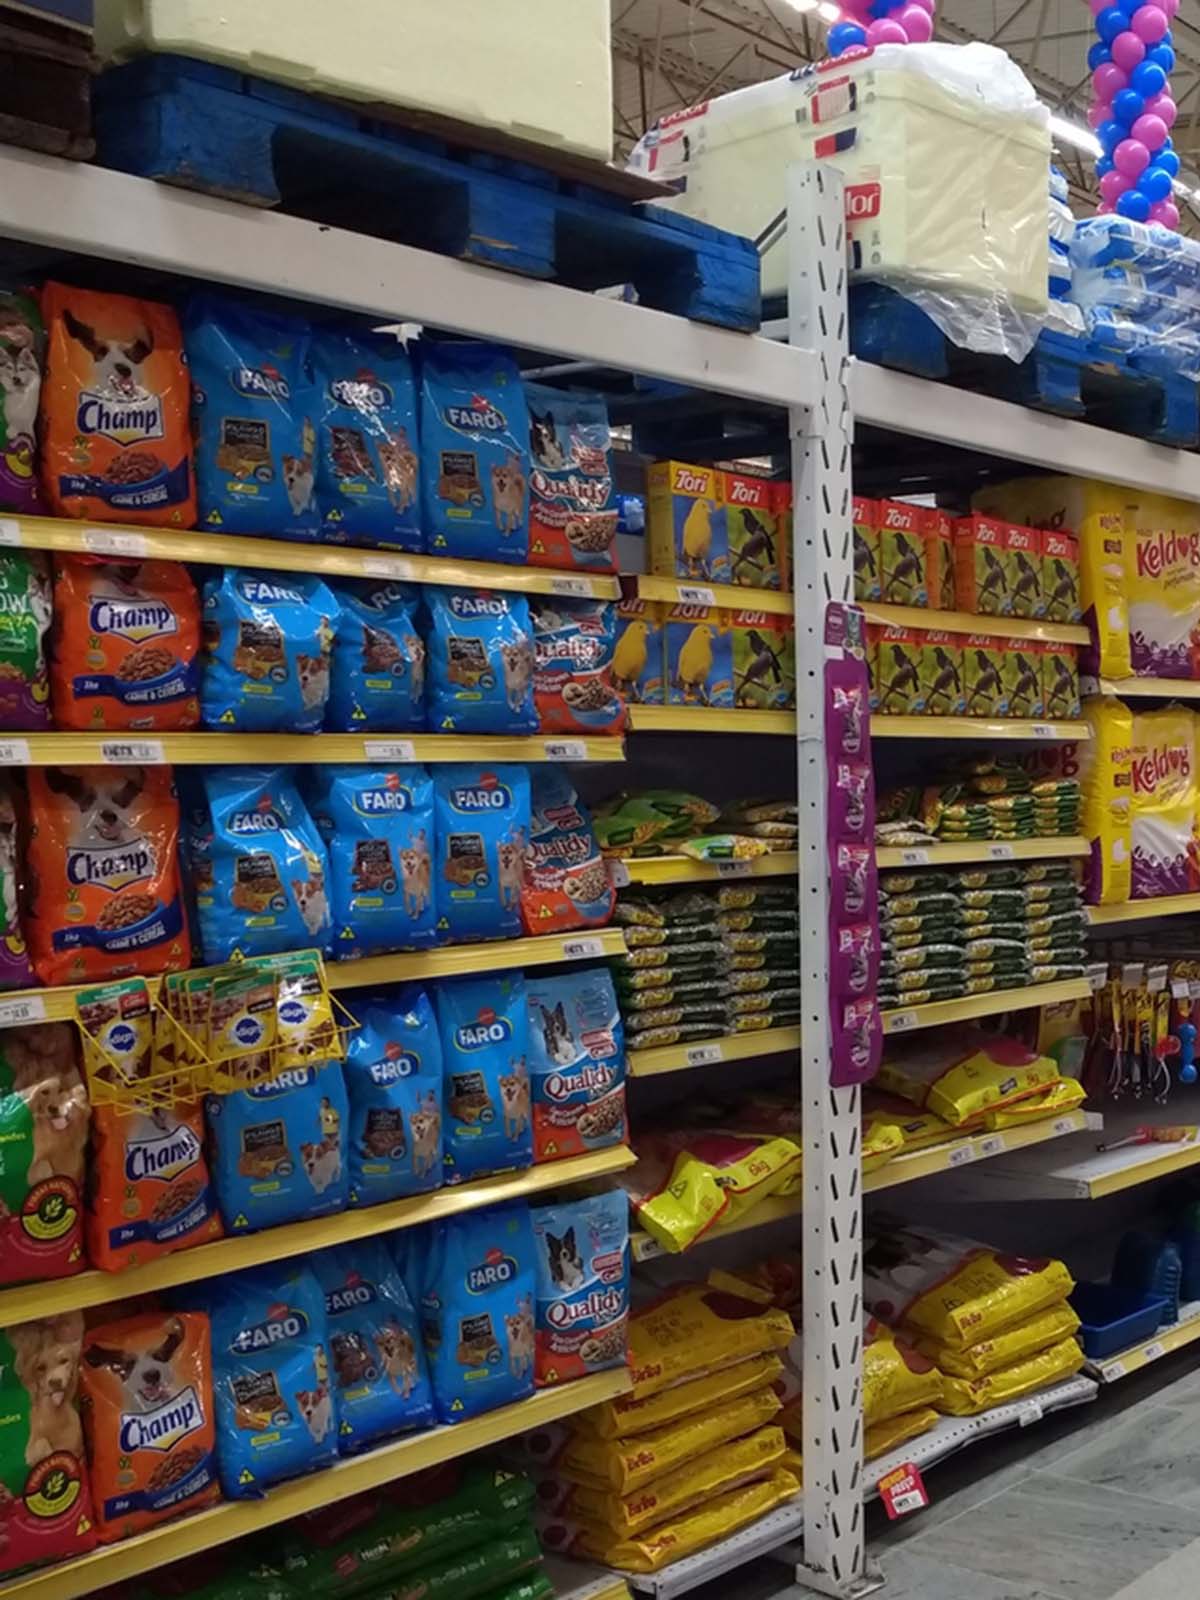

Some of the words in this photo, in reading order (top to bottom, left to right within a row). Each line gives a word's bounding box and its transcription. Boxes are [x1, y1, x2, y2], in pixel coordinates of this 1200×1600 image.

[77, 400, 158, 434] Champ
[449, 408, 499, 429] FARO
[676, 470, 709, 492] Tori
[730, 480, 761, 503] Tori
[885, 507, 913, 528] Tori
[451, 595, 502, 615] FARO
[90, 602, 170, 633] Champ
[361, 791, 405, 811] FARO
[455, 790, 505, 808] FARO
[232, 813, 279, 831] FARO
[67, 850, 149, 885] Champ
[458, 1023, 505, 1046] FARO
[370, 1058, 412, 1082] FARO
[470, 1263, 511, 1289] FARO
[238, 1316, 300, 1351] FARO
[120, 1401, 195, 1452] Champ
